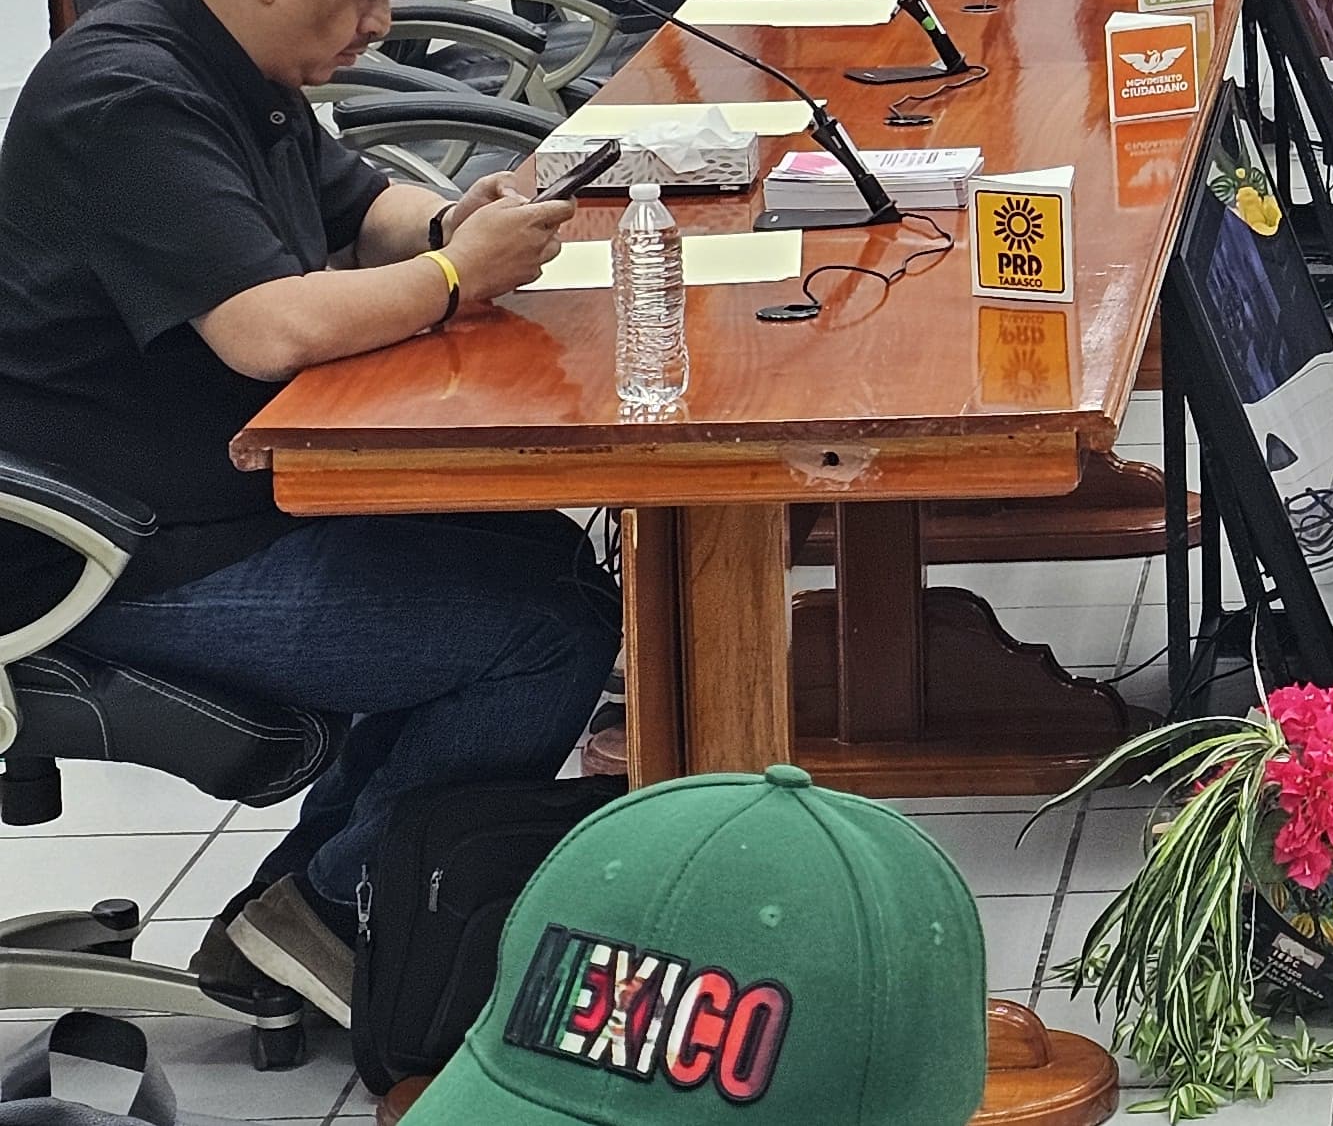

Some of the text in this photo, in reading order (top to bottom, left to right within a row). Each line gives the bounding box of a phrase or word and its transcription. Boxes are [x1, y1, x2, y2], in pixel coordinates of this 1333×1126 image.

[1125, 73, 1184, 87] MOVIMIENTO
[1120, 81, 1189, 99] CIUDADANO
[997, 252, 1043, 277] PRD
[998, 276, 1043, 288] TABASCO
